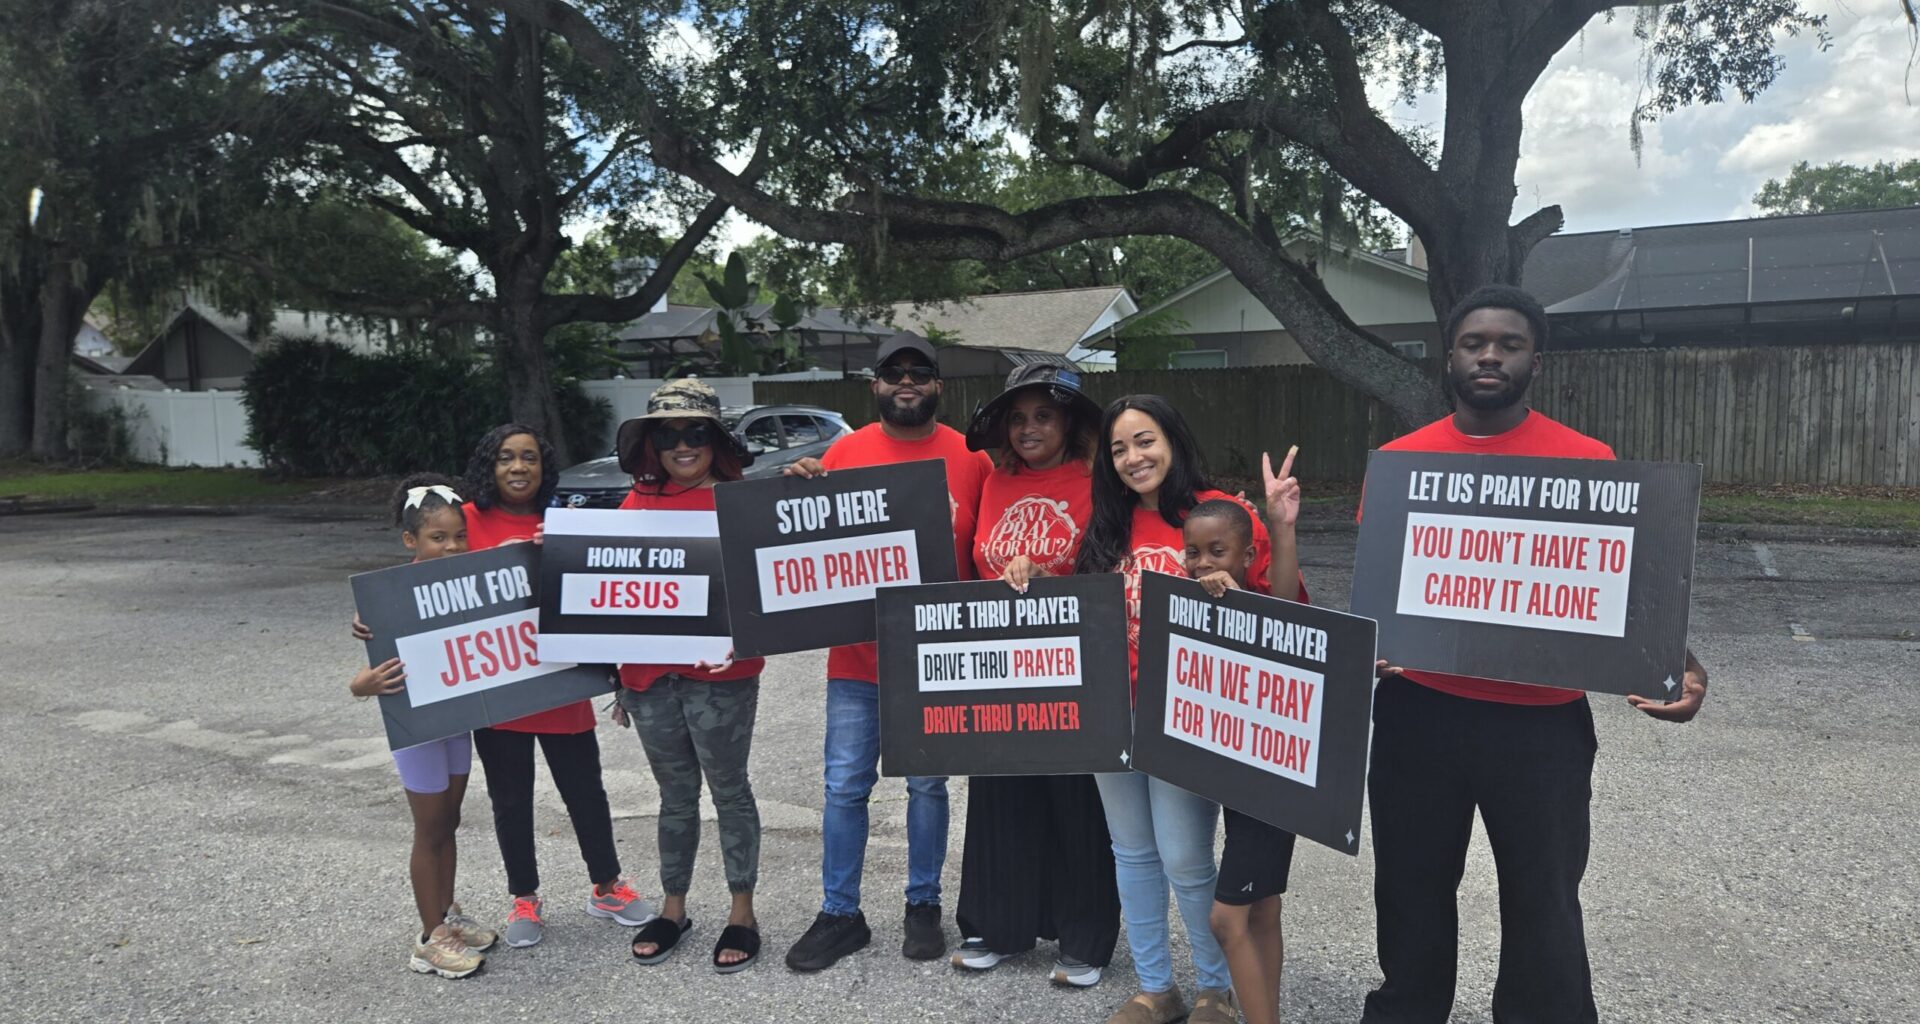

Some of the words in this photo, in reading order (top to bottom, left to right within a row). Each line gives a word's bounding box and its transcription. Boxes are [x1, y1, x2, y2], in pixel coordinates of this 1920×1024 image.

[776, 494, 830, 534] STOP
[835, 489, 890, 527] HERE
[1408, 471, 1443, 501] LET
[1446, 473, 1474, 504] US
[1479, 475, 1536, 507] PRAY
[1539, 477, 1580, 510] FOR
[1588, 480, 1640, 514] YOU!
[991, 540, 1022, 558] FOR
[1025, 537, 1067, 556] YOU?
[996, 520, 1057, 541] PRAY
[1412, 525, 1453, 559] YOU
[1459, 528, 1525, 565] DON'T
[1530, 533, 1590, 571] HAVE
[1597, 538, 1626, 574] TO
[586, 547, 642, 568] HONK
[647, 548, 686, 569] FOR
[773, 556, 817, 596] FOR
[823, 545, 909, 589] PRAYER
[413, 574, 484, 620] HONK
[485, 565, 532, 605] FOR
[590, 580, 680, 609] JESUS
[914, 602, 963, 632] DRIVE
[966, 599, 1010, 629] THRU
[1015, 596, 1080, 627] PRAYER
[1424, 572, 1496, 610] CARRY
[1499, 578, 1523, 613] IT
[1526, 582, 1600, 621] ALONE
[1169, 594, 1212, 633] DRIVE
[1215, 604, 1257, 645] THRU
[1261, 618, 1328, 663] PRAYER
[440, 621, 540, 687] JESUS
[924, 652, 966, 682] DRIVE
[970, 650, 1008, 680] THRU
[1013, 647, 1076, 678] PRAYER
[1176, 647, 1214, 694] CAN
[1219, 659, 1252, 705] WE
[1256, 670, 1314, 724] PRAY
[923, 705, 968, 734] DRIVE
[971, 703, 1012, 733] THRU
[1016, 701, 1080, 731] PRAYER
[1172, 697, 1204, 738] FOR
[1210, 708, 1244, 752] YOU
[1250, 722, 1311, 774] TODAY
